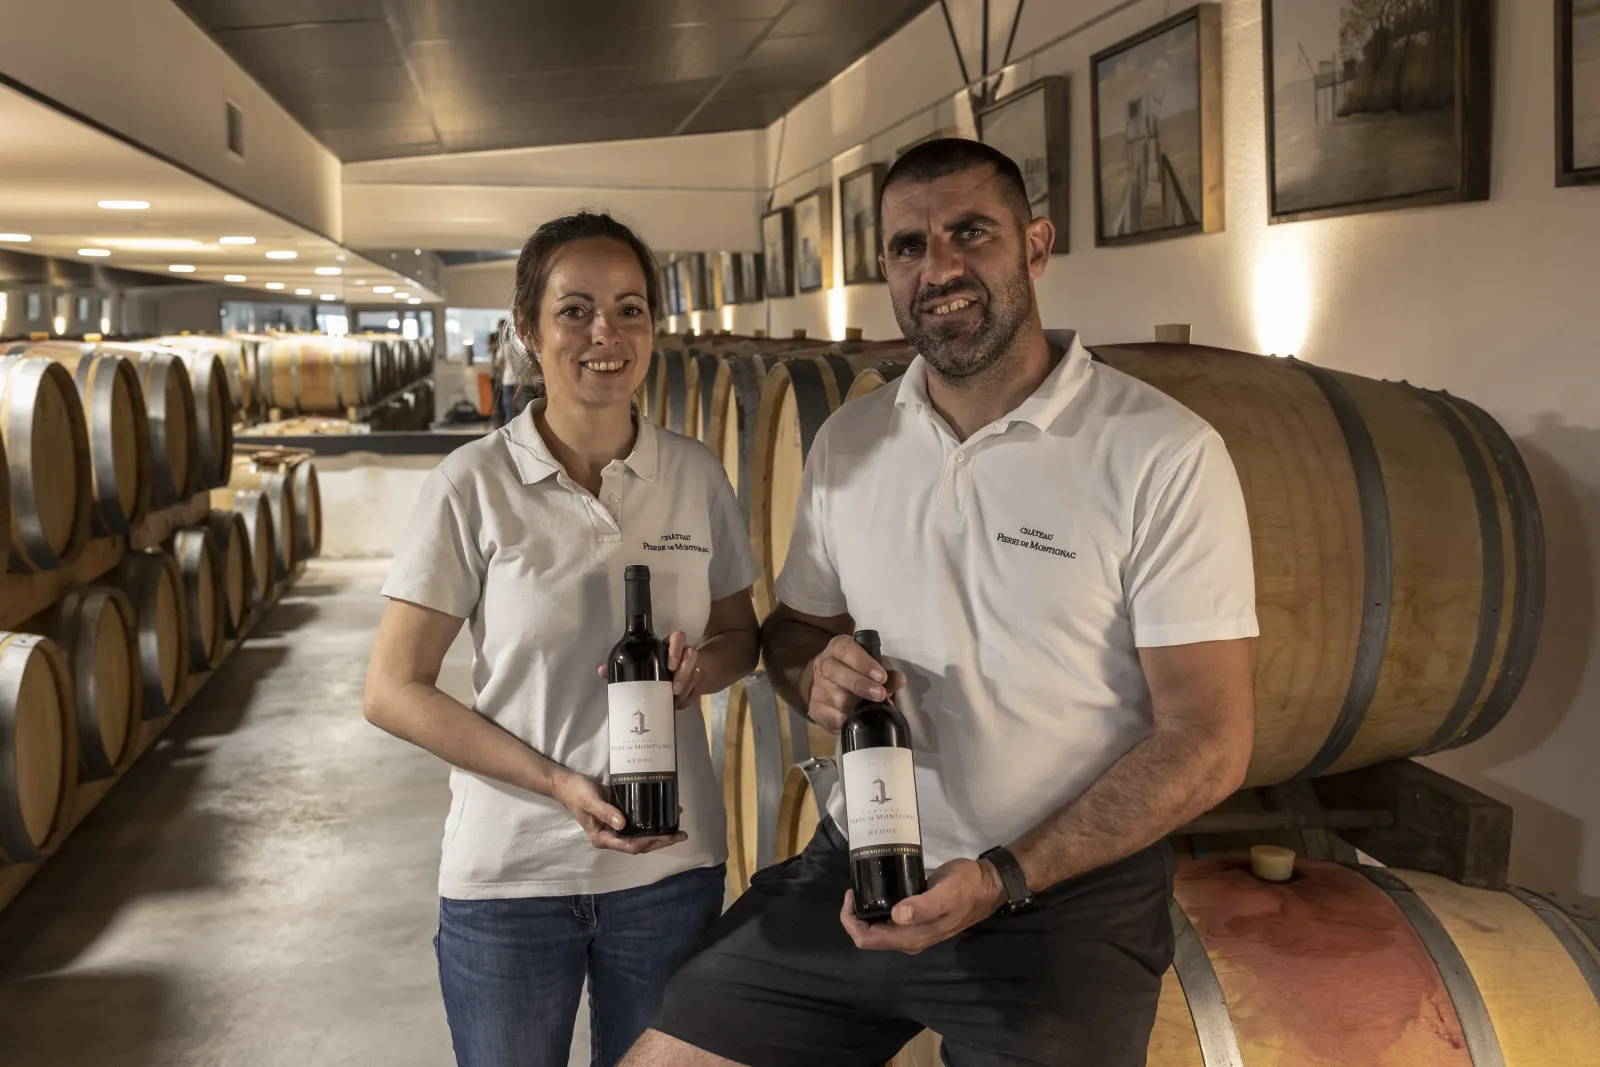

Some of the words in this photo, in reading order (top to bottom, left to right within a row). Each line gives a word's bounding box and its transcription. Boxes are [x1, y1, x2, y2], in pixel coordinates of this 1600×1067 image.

[643, 542, 667, 552] PIERRE
[675, 543, 711, 554] MONTIGNAC
[996, 532, 1020, 546] PIERRE
[1020, 540, 1029, 548] DE
[1029, 540, 1077, 559] MONTIGNAC
